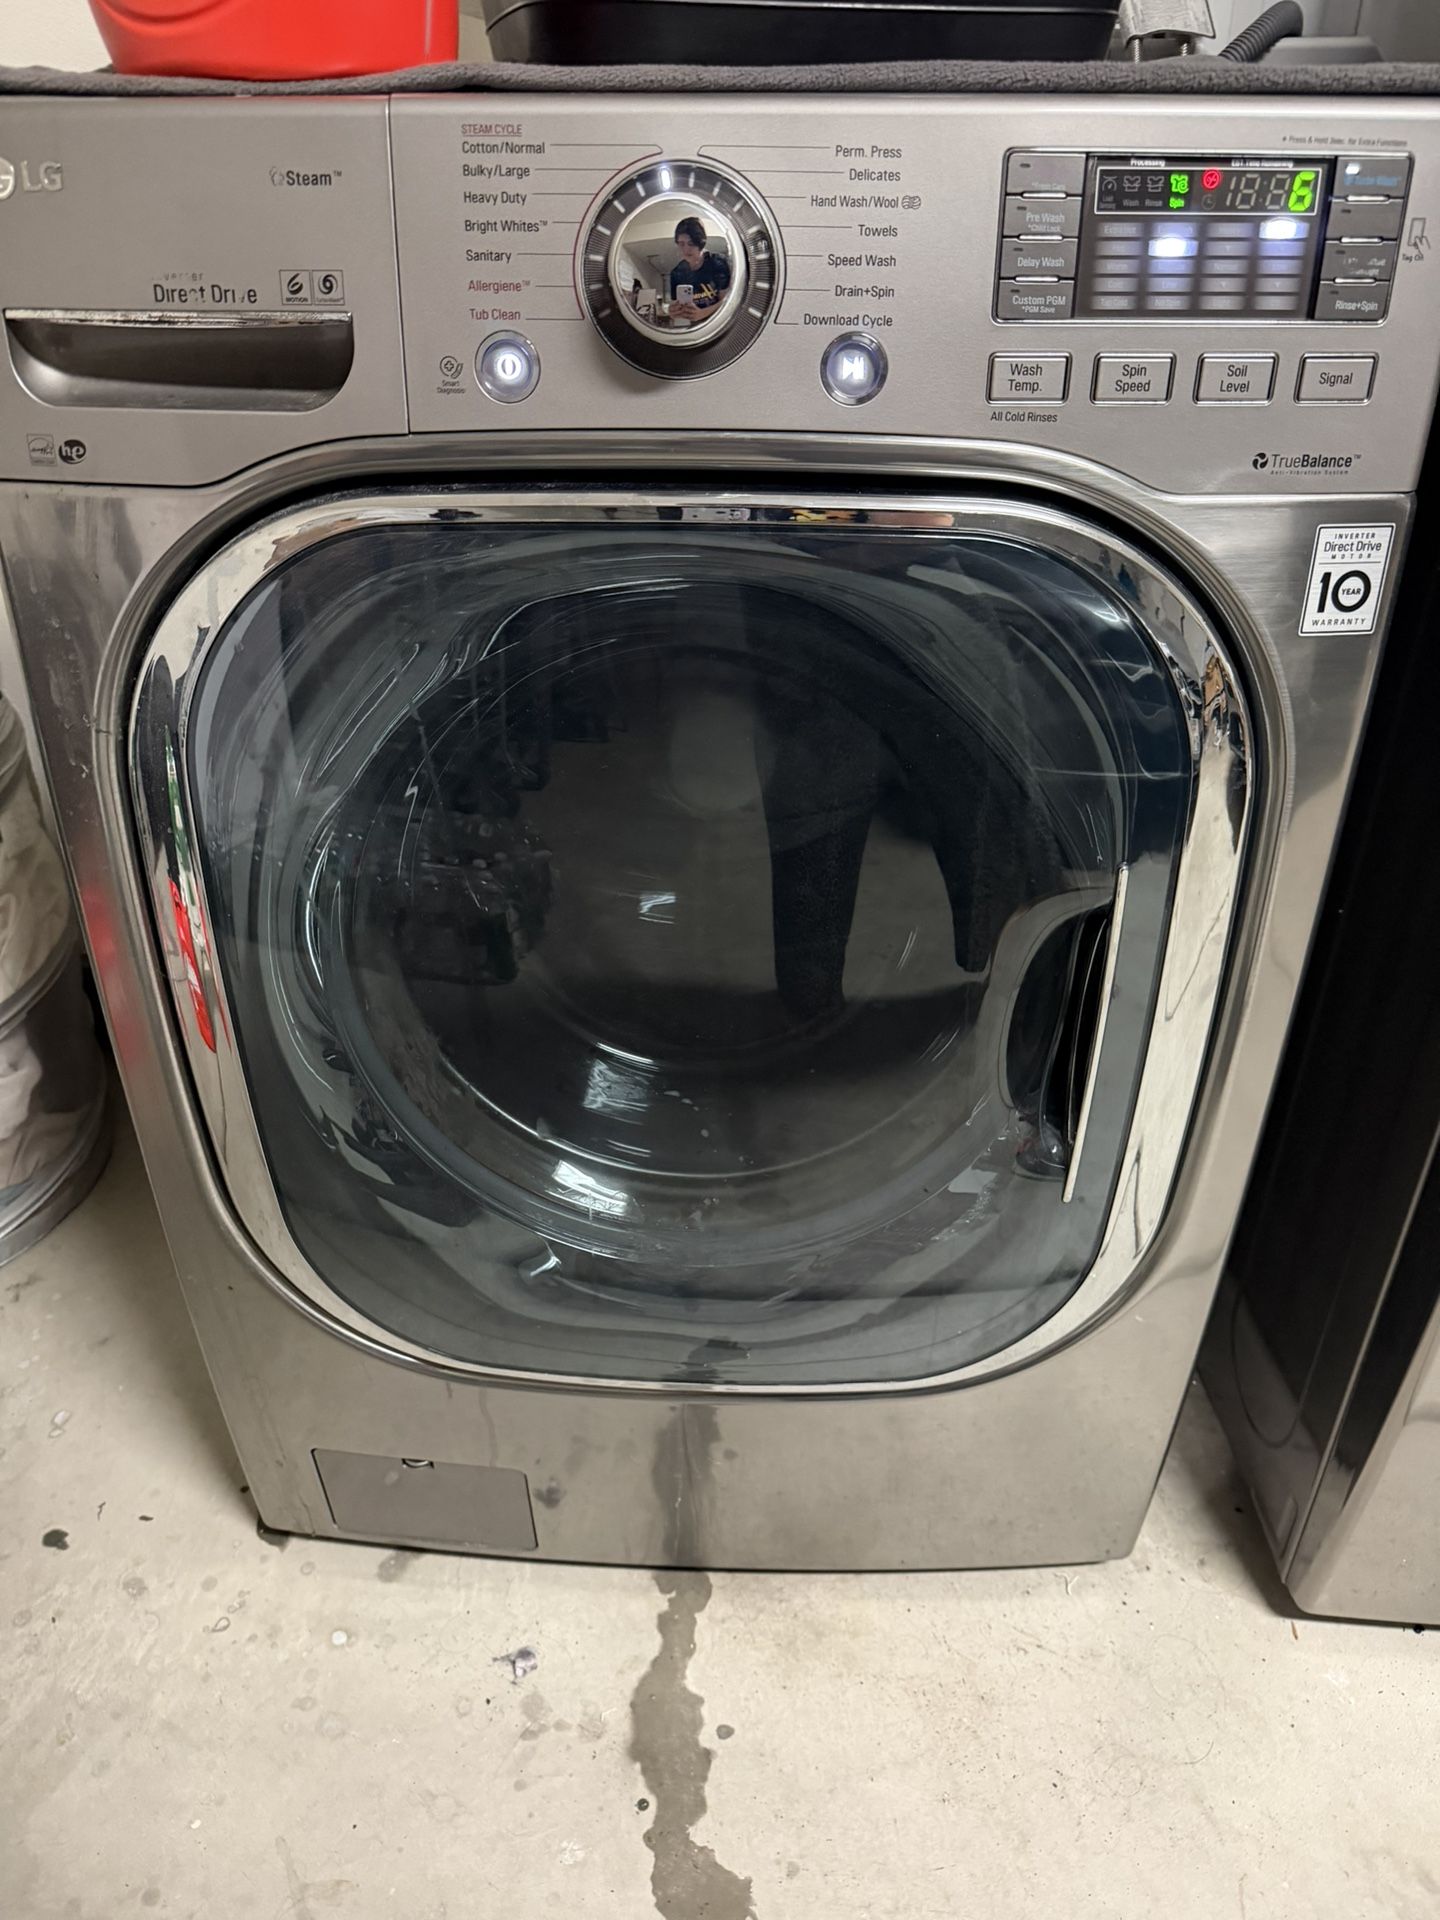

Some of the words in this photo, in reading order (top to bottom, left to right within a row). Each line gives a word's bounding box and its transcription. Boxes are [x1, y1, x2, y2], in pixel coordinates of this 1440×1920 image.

[462, 124, 493, 135] STEAM
[494, 125, 523, 136] CYCLE
[462, 141, 545, 154] Cotton/Normal
[835, 144, 868, 158] Perm.
[871, 145, 903, 159] Press
[20, 160, 63, 192] LG
[462, 163, 530, 180] Bulky/Large
[849, 168, 901, 182] Delicates
[464, 191, 498, 207] Heavy
[501, 191, 527, 207] Duty
[811, 195, 836, 208] Hand
[839, 196, 899, 209] Wash/Wool
[1026, 212, 1040, 223] Pre
[1041, 213, 1065, 224] Wash
[465, 219, 498, 234] Bright
[858, 224, 898, 238] Towels
[466, 249, 512, 264] Sanitary
[828, 254, 862, 268] Speed
[865, 255, 896, 267] Wash
[1017, 257, 1039, 270] Delay
[1041, 258, 1065, 268] Wash
[835, 285, 894, 299] Drain+Spin
[1013, 296, 1044, 305] Custom
[1046, 296, 1066, 305] PGM
[1335, 301, 1378, 312] Rinse+Spin
[470, 309, 489, 320] Tub
[492, 310, 520, 320] Clean
[804, 314, 859, 326] Download
[862, 315, 893, 328] Cycle
[1010, 364, 1042, 376] Wash
[1122, 364, 1147, 379] Spin
[1227, 364, 1247, 377] Soil
[1008, 379, 1042, 393] Temp.
[1319, 372, 1353, 386] Signal
[1115, 380, 1151, 395] Speed
[1220, 380, 1249, 393] Level
[991, 412, 1002, 421] All
[1005, 412, 1025, 422] Cold
[1027, 413, 1058, 423] Rinses
[1324, 542, 1354, 552] Direct
[1356, 541, 1382, 551] Drive
[1317, 570, 1371, 613] 10
[1312, 618, 1366, 626] WARRANTY
